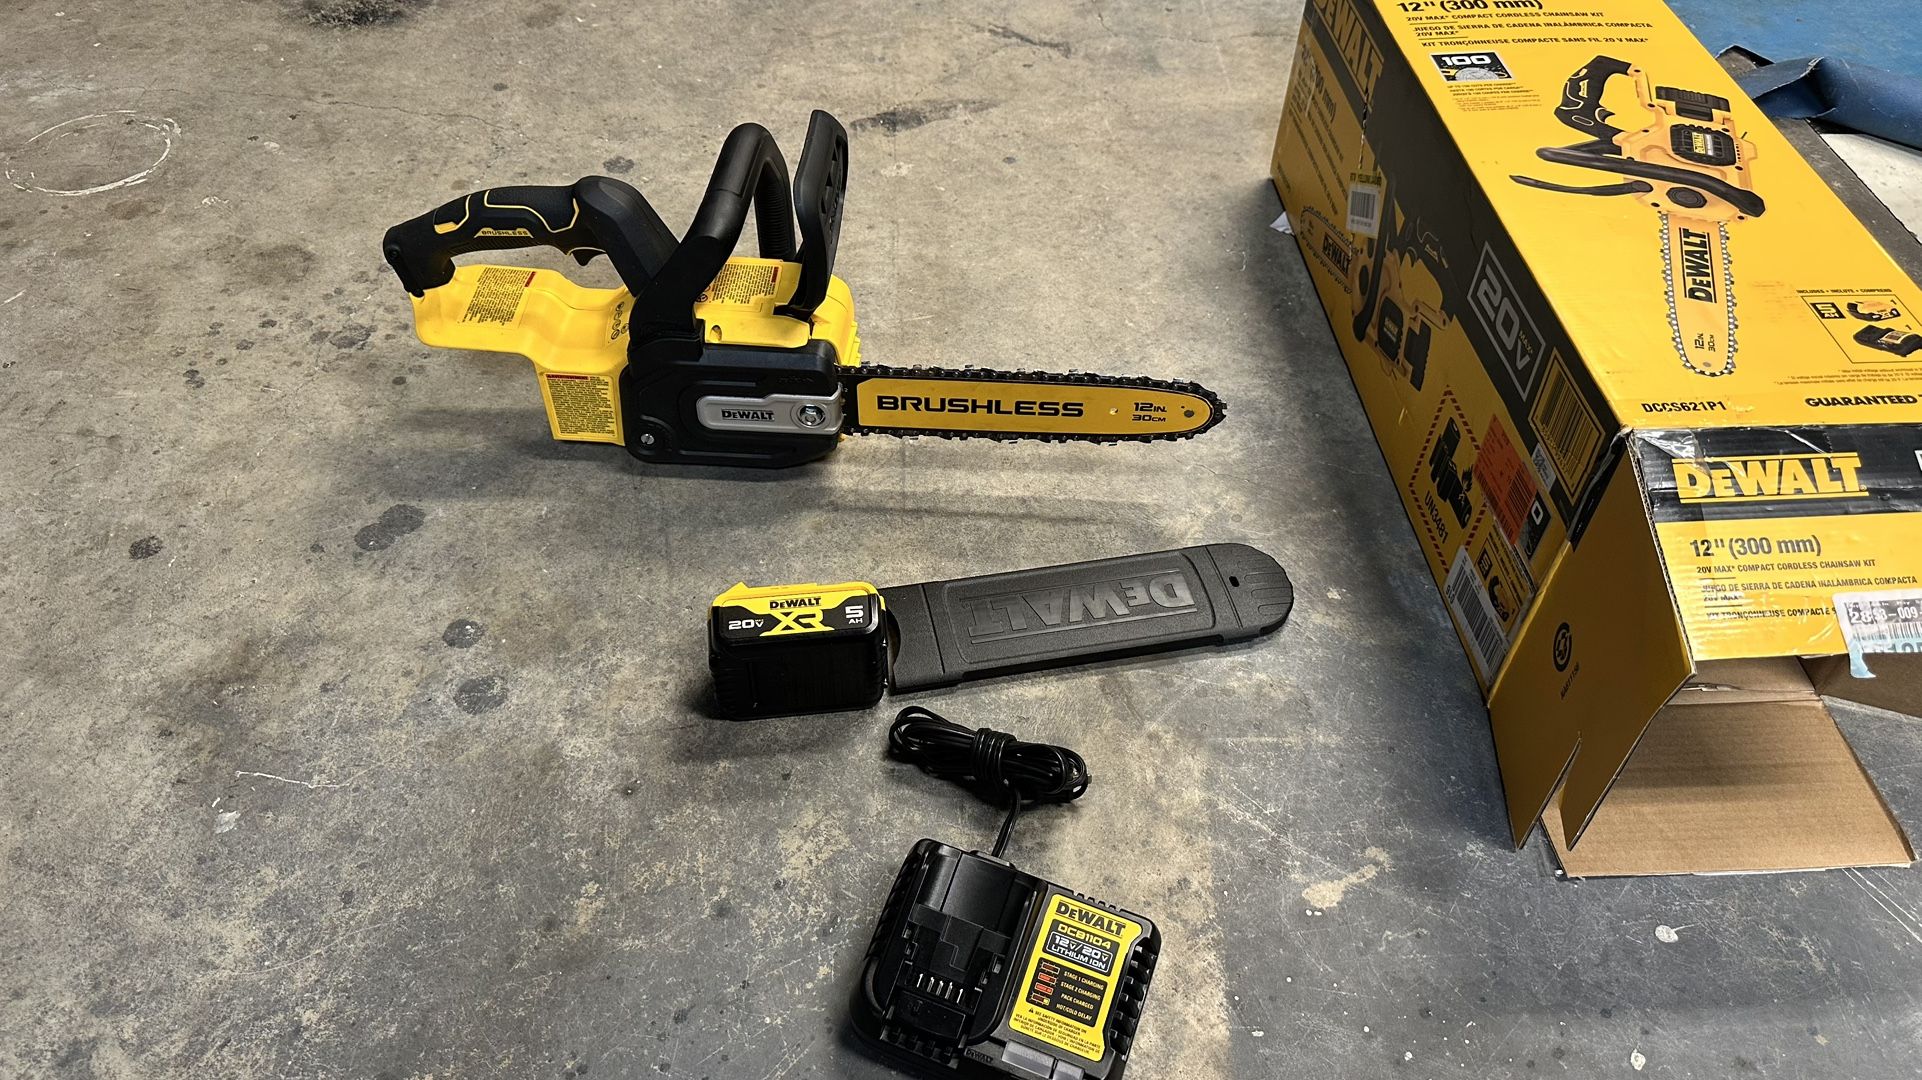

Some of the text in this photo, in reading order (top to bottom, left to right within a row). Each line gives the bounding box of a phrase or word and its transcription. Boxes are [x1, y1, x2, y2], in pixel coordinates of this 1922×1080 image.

[1397, 0, 1543, 12] 12" (300 mm)
[1441, 55, 1491, 66] 100
[1682, 228, 1712, 303] DEWALT
[877, 395, 1084, 418] BRUSHLESS
[1641, 394, 1918, 413] DCCS621P1 GUARANTEED
[1132, 414, 1166, 423] 30CM
[1673, 457, 1862, 498] DEWALT
[1425, 491, 1448, 544] UN3481
[1690, 534, 1822, 560] 12" (300 mm)
[1696, 566, 1711, 574] 20V
[1737, 563, 1775, 573] COMPACT
[1777, 561, 1818, 570] CORDLESS
[1820, 559, 1861, 568] CHAINSAW
[1863, 559, 1876, 567] KIT
[1729, 583, 1740, 591] DE
[1742, 582, 1770, 591] SIERRA
[1772, 581, 1783, 590] DE
[1785, 580, 1817, 589] CADENA
[1874, 575, 1918, 585] COMPACTA
[770, 598, 821, 610] DEWALT
[845, 605, 864, 618] 5
[967, 570, 1194, 636] DEWALT
[1787, 607, 1830, 617] COMPACTE
[728, 609, 835, 636] 20V XR
[848, 617, 863, 625] AH
[1056, 902, 1126, 936] DEWALT
[1058, 923, 1112, 949] DCB1104
[1051, 944, 1107, 970] LITHIUM ION
[1063, 971, 1078, 980] STAGE
[1081, 977, 1104, 990] CHARGING
[1060, 981, 1075, 991] STAGE
[1078, 988, 1101, 1001] CHARGING
[1061, 993, 1094, 1010] PACK CHARGED
[1078, 1011, 1093, 1021] DELAY
